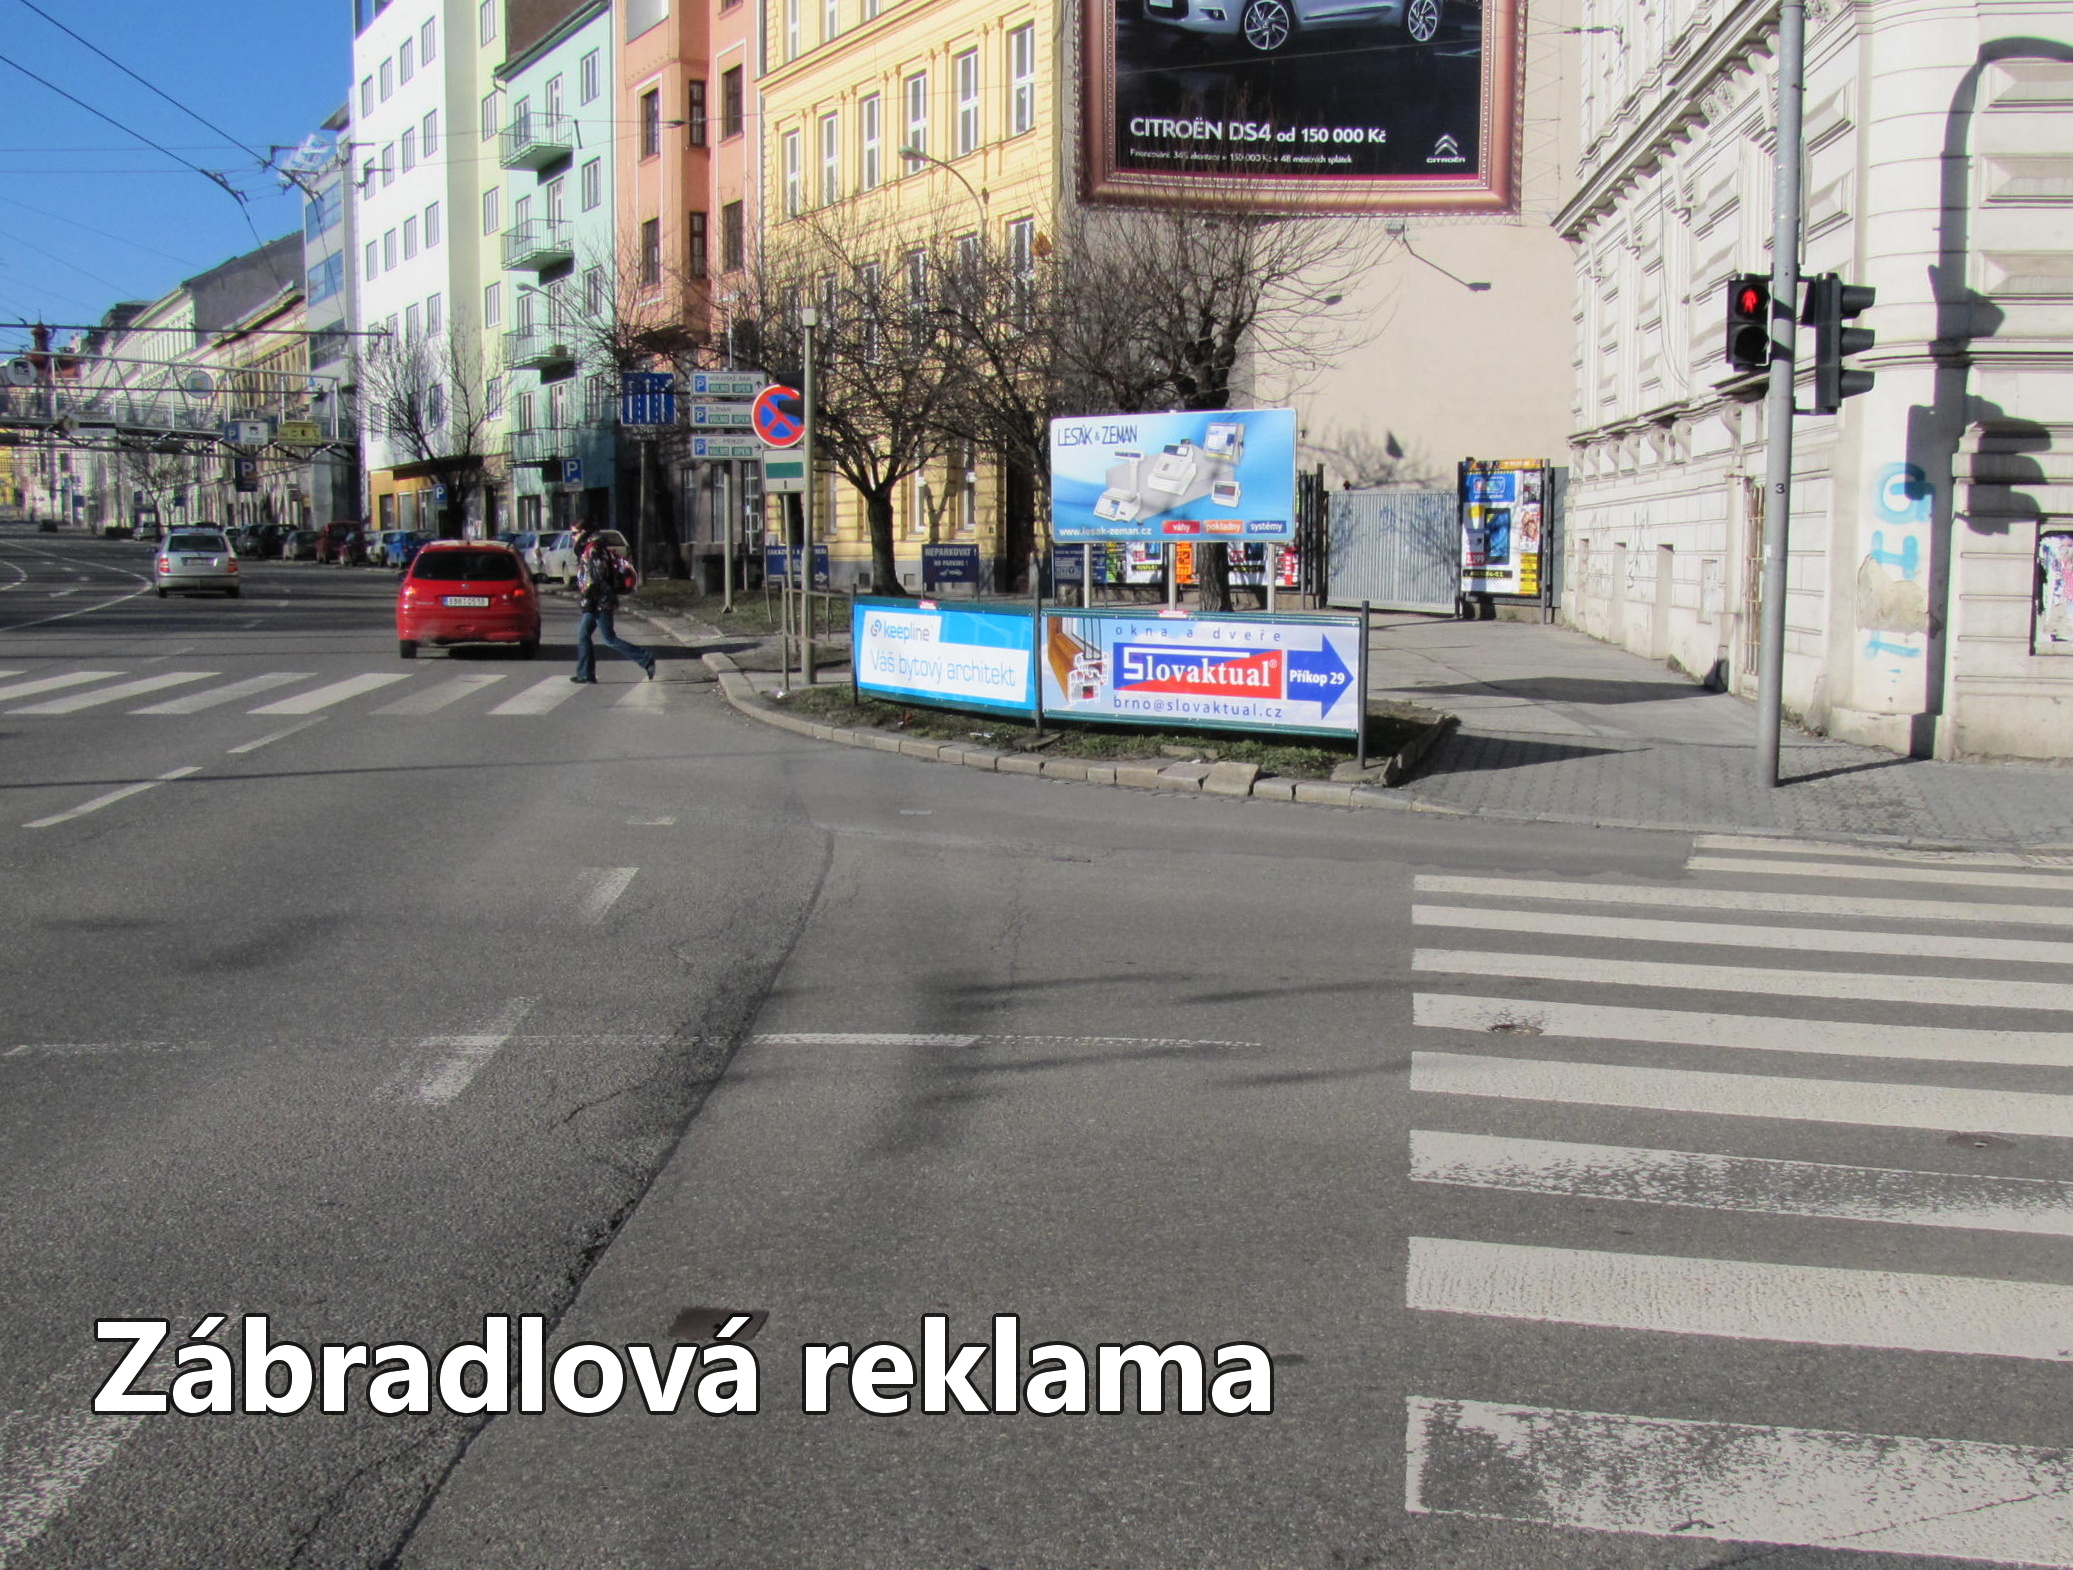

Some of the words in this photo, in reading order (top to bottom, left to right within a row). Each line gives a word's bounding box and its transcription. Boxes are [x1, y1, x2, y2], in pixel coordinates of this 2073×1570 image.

[1130, 117, 1223, 140] CITROËN
[1229, 121, 1271, 142] DS4
[1276, 127, 1296, 142] od
[1301, 128, 1329, 143] 150
[1332, 128, 1364, 143] 000
[1368, 128, 1387, 143] Kč
[1102, 424, 1137, 445] ZEMAN
[1775, 483, 1785, 494] 3
[1172, 522, 1191, 533] váhy
[1206, 522, 1241, 533] pokladny
[1250, 522, 1283, 533] systémy
[884, 620, 930, 644] keepline
[1115, 624, 1168, 637] okna
[1186, 628, 1194, 638] a
[1212, 625, 1281, 642] dveře
[870, 649, 895, 673] Váš
[899, 653, 943, 685] bytový
[947, 659, 1016, 687] architekt
[1289, 669, 1328, 687] Příkop
[1329, 672, 1345, 685] 29
[1113, 695, 1283, 718] brno@slovaktual.cz
